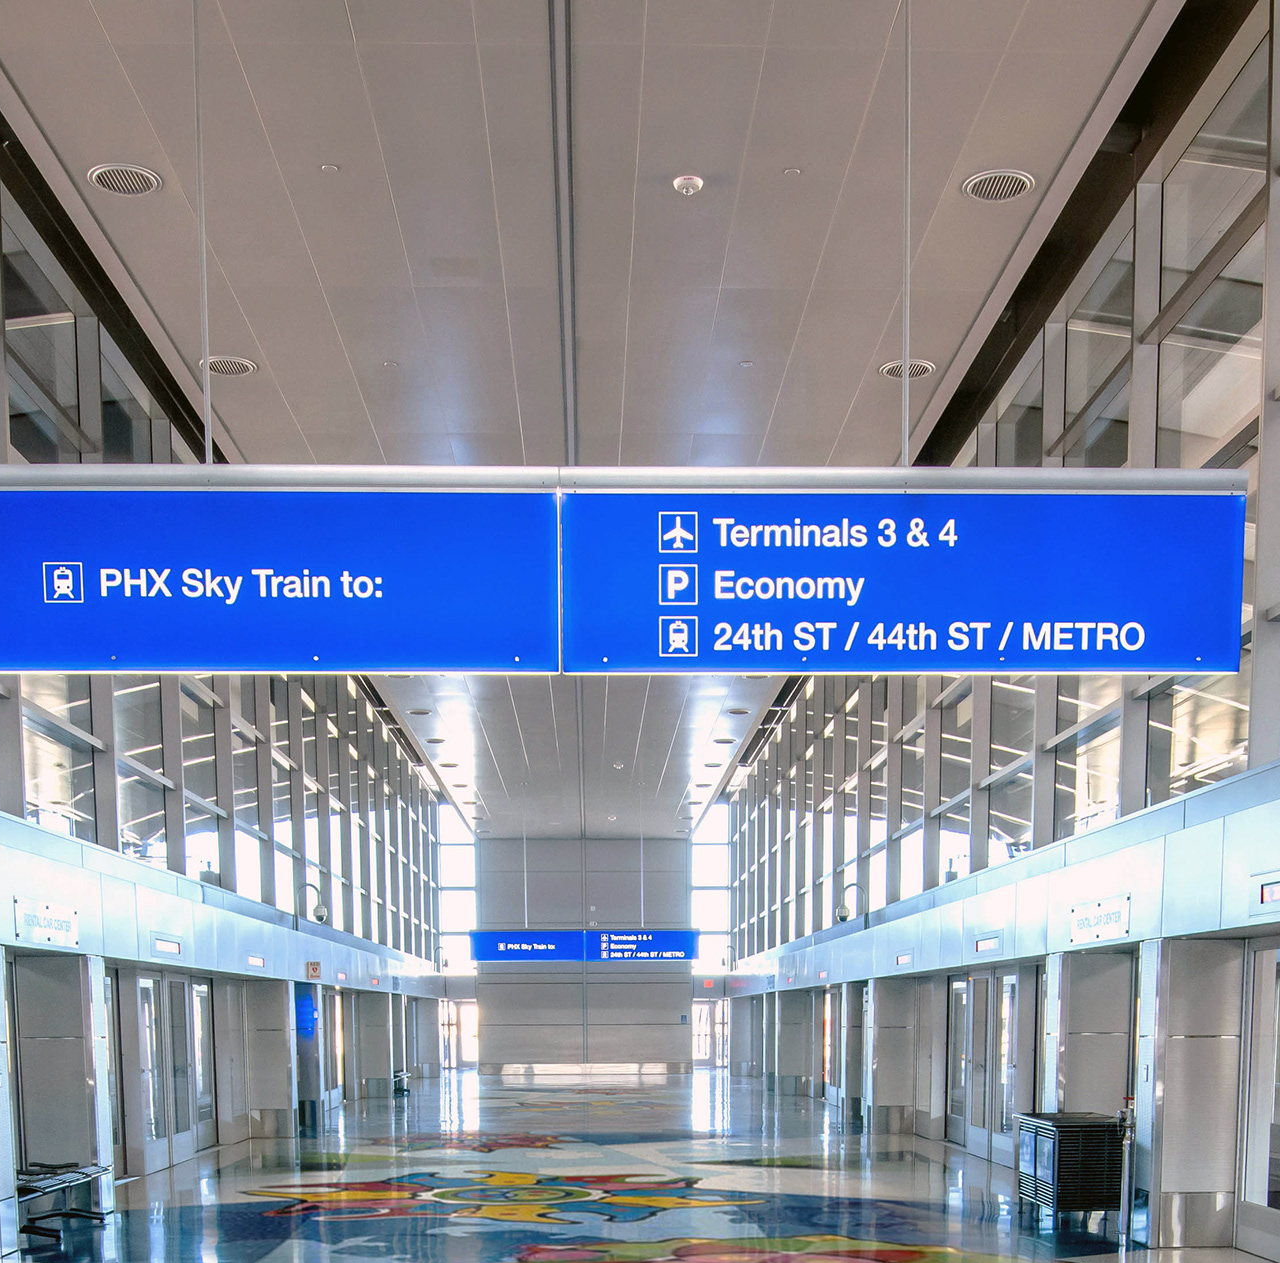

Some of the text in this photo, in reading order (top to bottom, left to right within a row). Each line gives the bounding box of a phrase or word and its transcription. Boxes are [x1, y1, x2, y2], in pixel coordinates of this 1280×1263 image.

[713, 518, 958, 547] Terminals 3 & 4
[100, 568, 383, 604] PHX Sky Train to:
[714, 570, 865, 606] Economy
[714, 622, 1146, 650] 24th ST / 44th ST / METRO
[23, 913, 42, 927] RENTAL
[54, 919, 71, 932] CENTER
[609, 943, 637, 951] Economy
